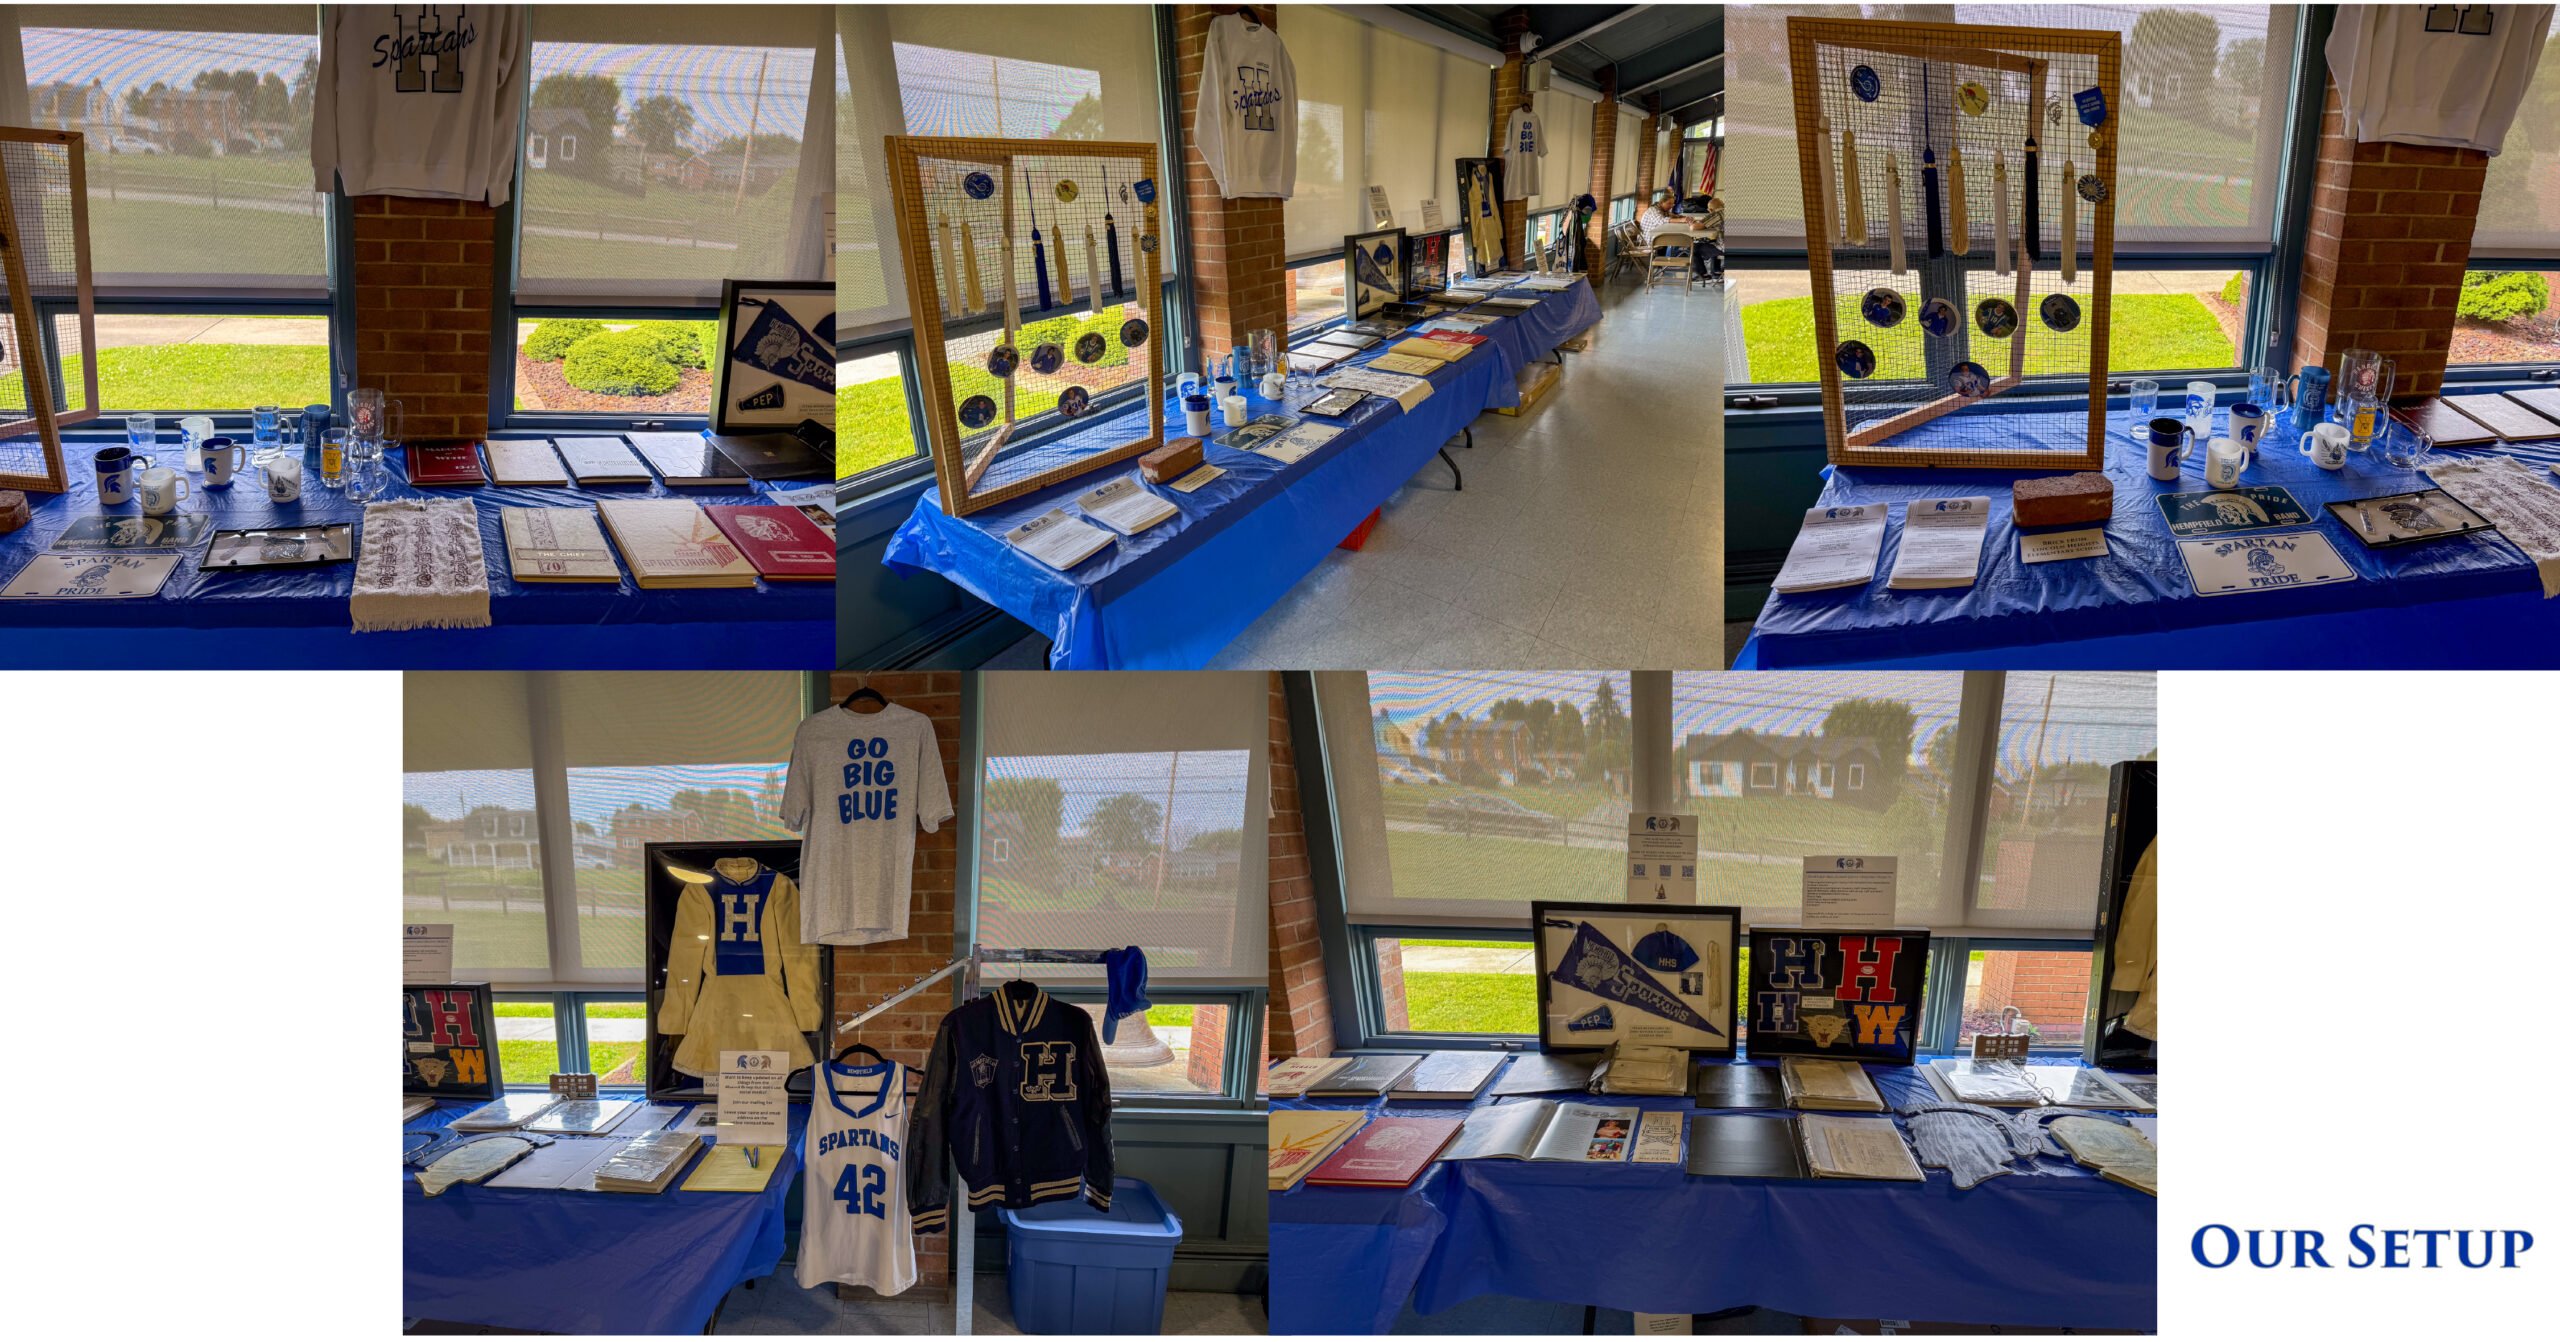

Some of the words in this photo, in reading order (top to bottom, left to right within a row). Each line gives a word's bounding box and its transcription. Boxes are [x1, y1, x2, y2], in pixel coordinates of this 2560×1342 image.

[372, 22, 479, 74] Spartans
[1237, 66, 1274, 132] H
[752, 393, 774, 407] PEP
[2179, 500, 2202, 511] THE
[2250, 493, 2288, 504] PRIDE
[2172, 519, 2223, 531] HEMPFIELD
[2273, 511, 2300, 521] BAND
[64, 556, 145, 569] SPARTAN
[642, 557, 718, 568] SPARTONIAN
[2215, 538, 2298, 558] SPARTAN
[544, 561, 562, 572] 70
[2249, 573, 2301, 587] PRIDE
[56, 587, 106, 595] PRIDE
[847, 737, 889, 760] GO
[843, 760, 895, 789] BIG
[838, 788, 898, 824] BLUE
[721, 894, 760, 942] H
[1658, 957, 1677, 968] HHS
[1769, 938, 1826, 989] H
[1835, 936, 1903, 1003] H
[1610, 963, 1690, 1023] Spartans
[424, 990, 480, 1048] H
[1580, 1014, 1601, 1028] PEP
[1757, 991, 1800, 1033] H
[1853, 1004, 1906, 1045] W
[448, 1048, 487, 1084] W
[1020, 1041, 1077, 1101] H
[819, 1128, 899, 1162] SPARTANS
[833, 1163, 886, 1220] 42
